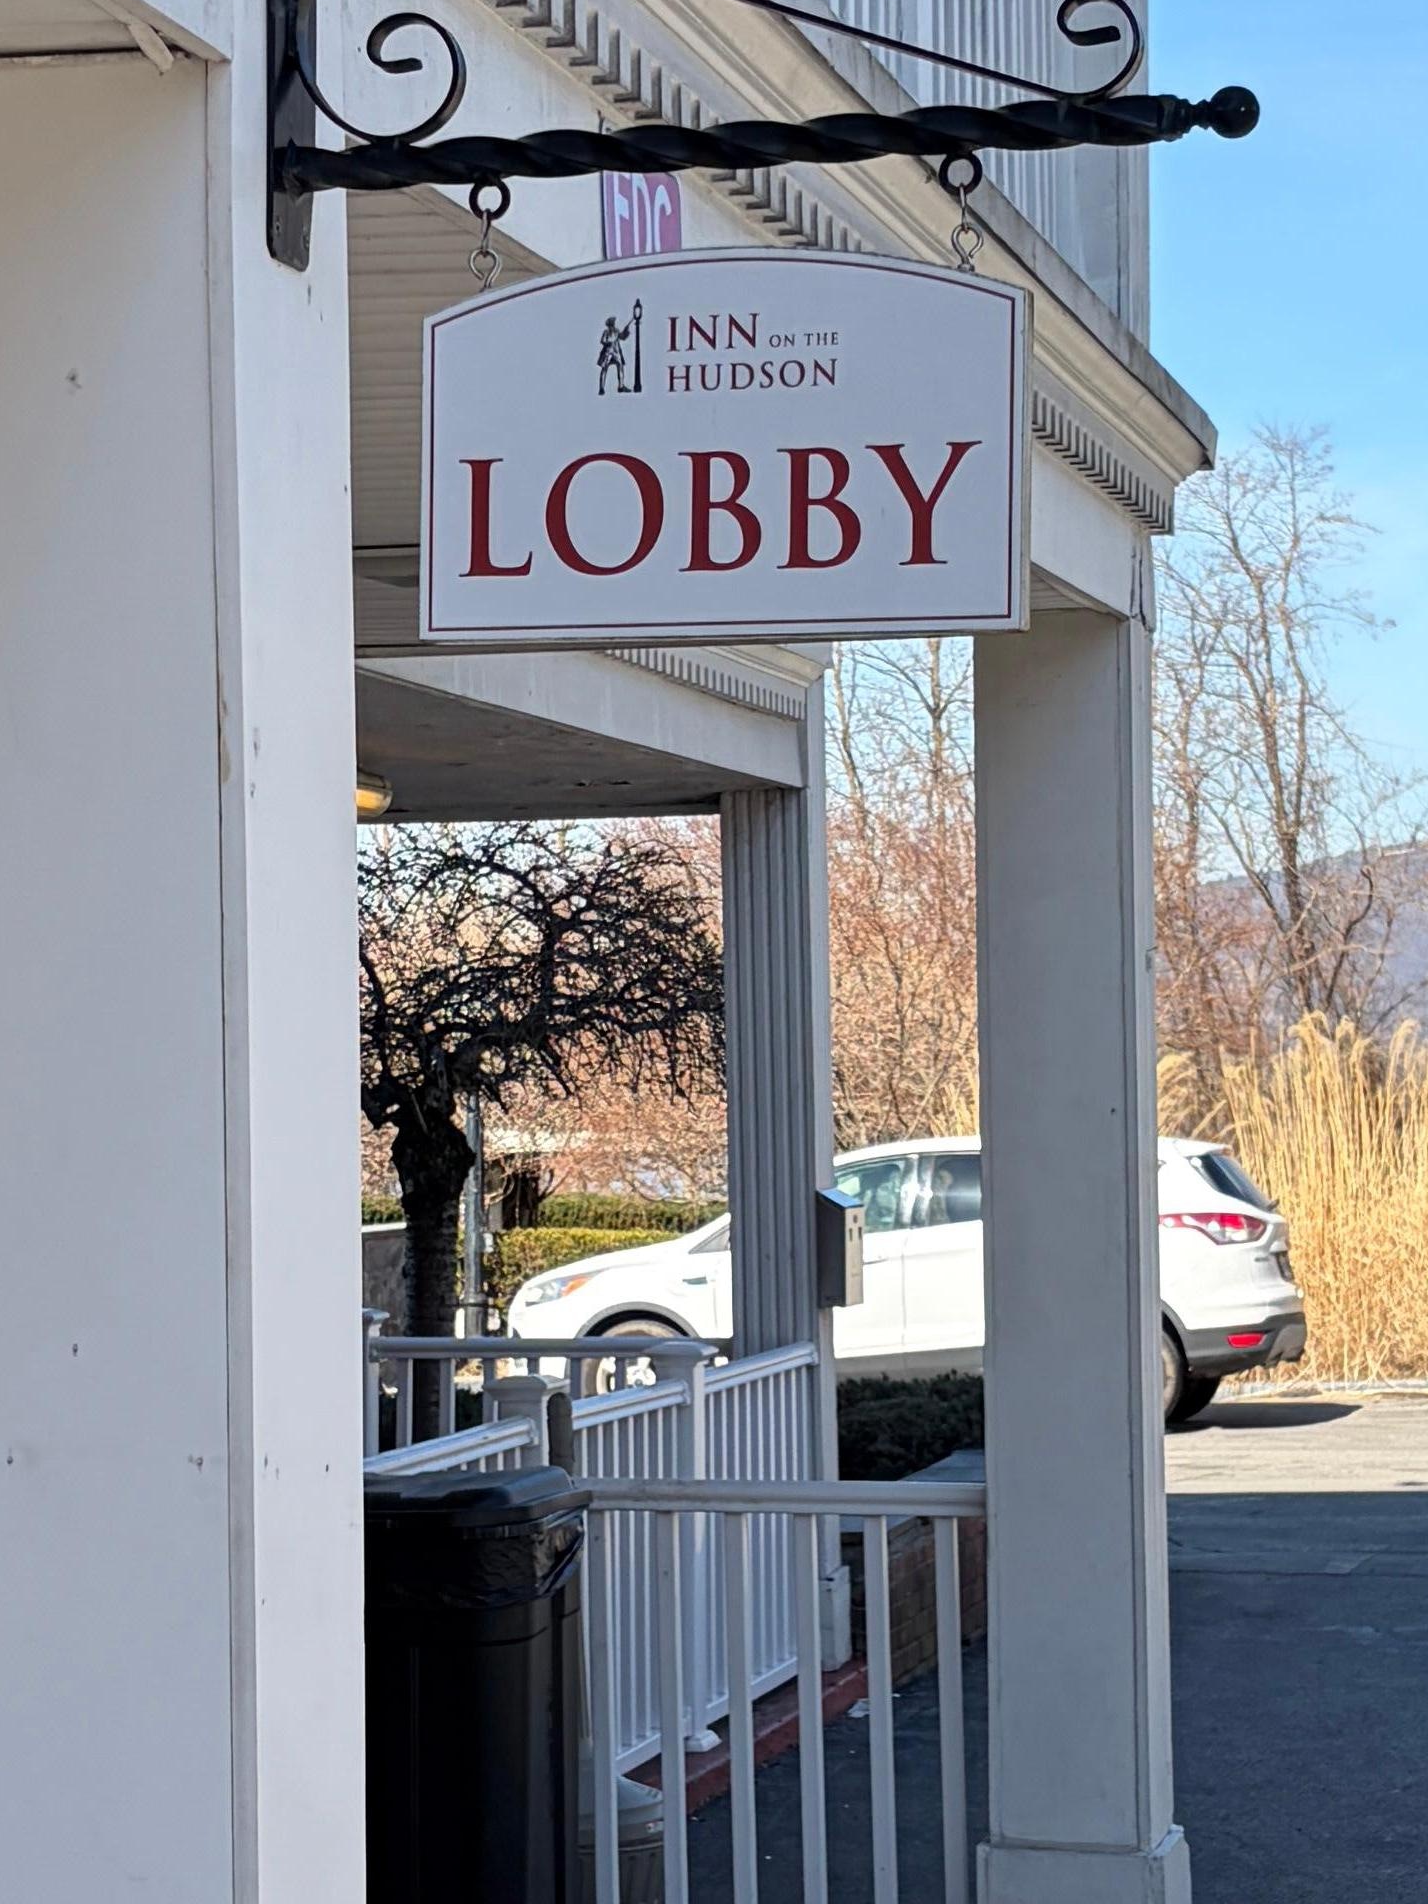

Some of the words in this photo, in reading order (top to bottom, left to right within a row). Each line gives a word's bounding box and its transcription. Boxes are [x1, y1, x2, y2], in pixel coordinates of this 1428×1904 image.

[666, 312, 761, 352] INN
[769, 334, 796, 348] ON
[804, 331, 840, 347] THE
[667, 358, 838, 393] HUDSON
[459, 440, 983, 577] LOBBY
